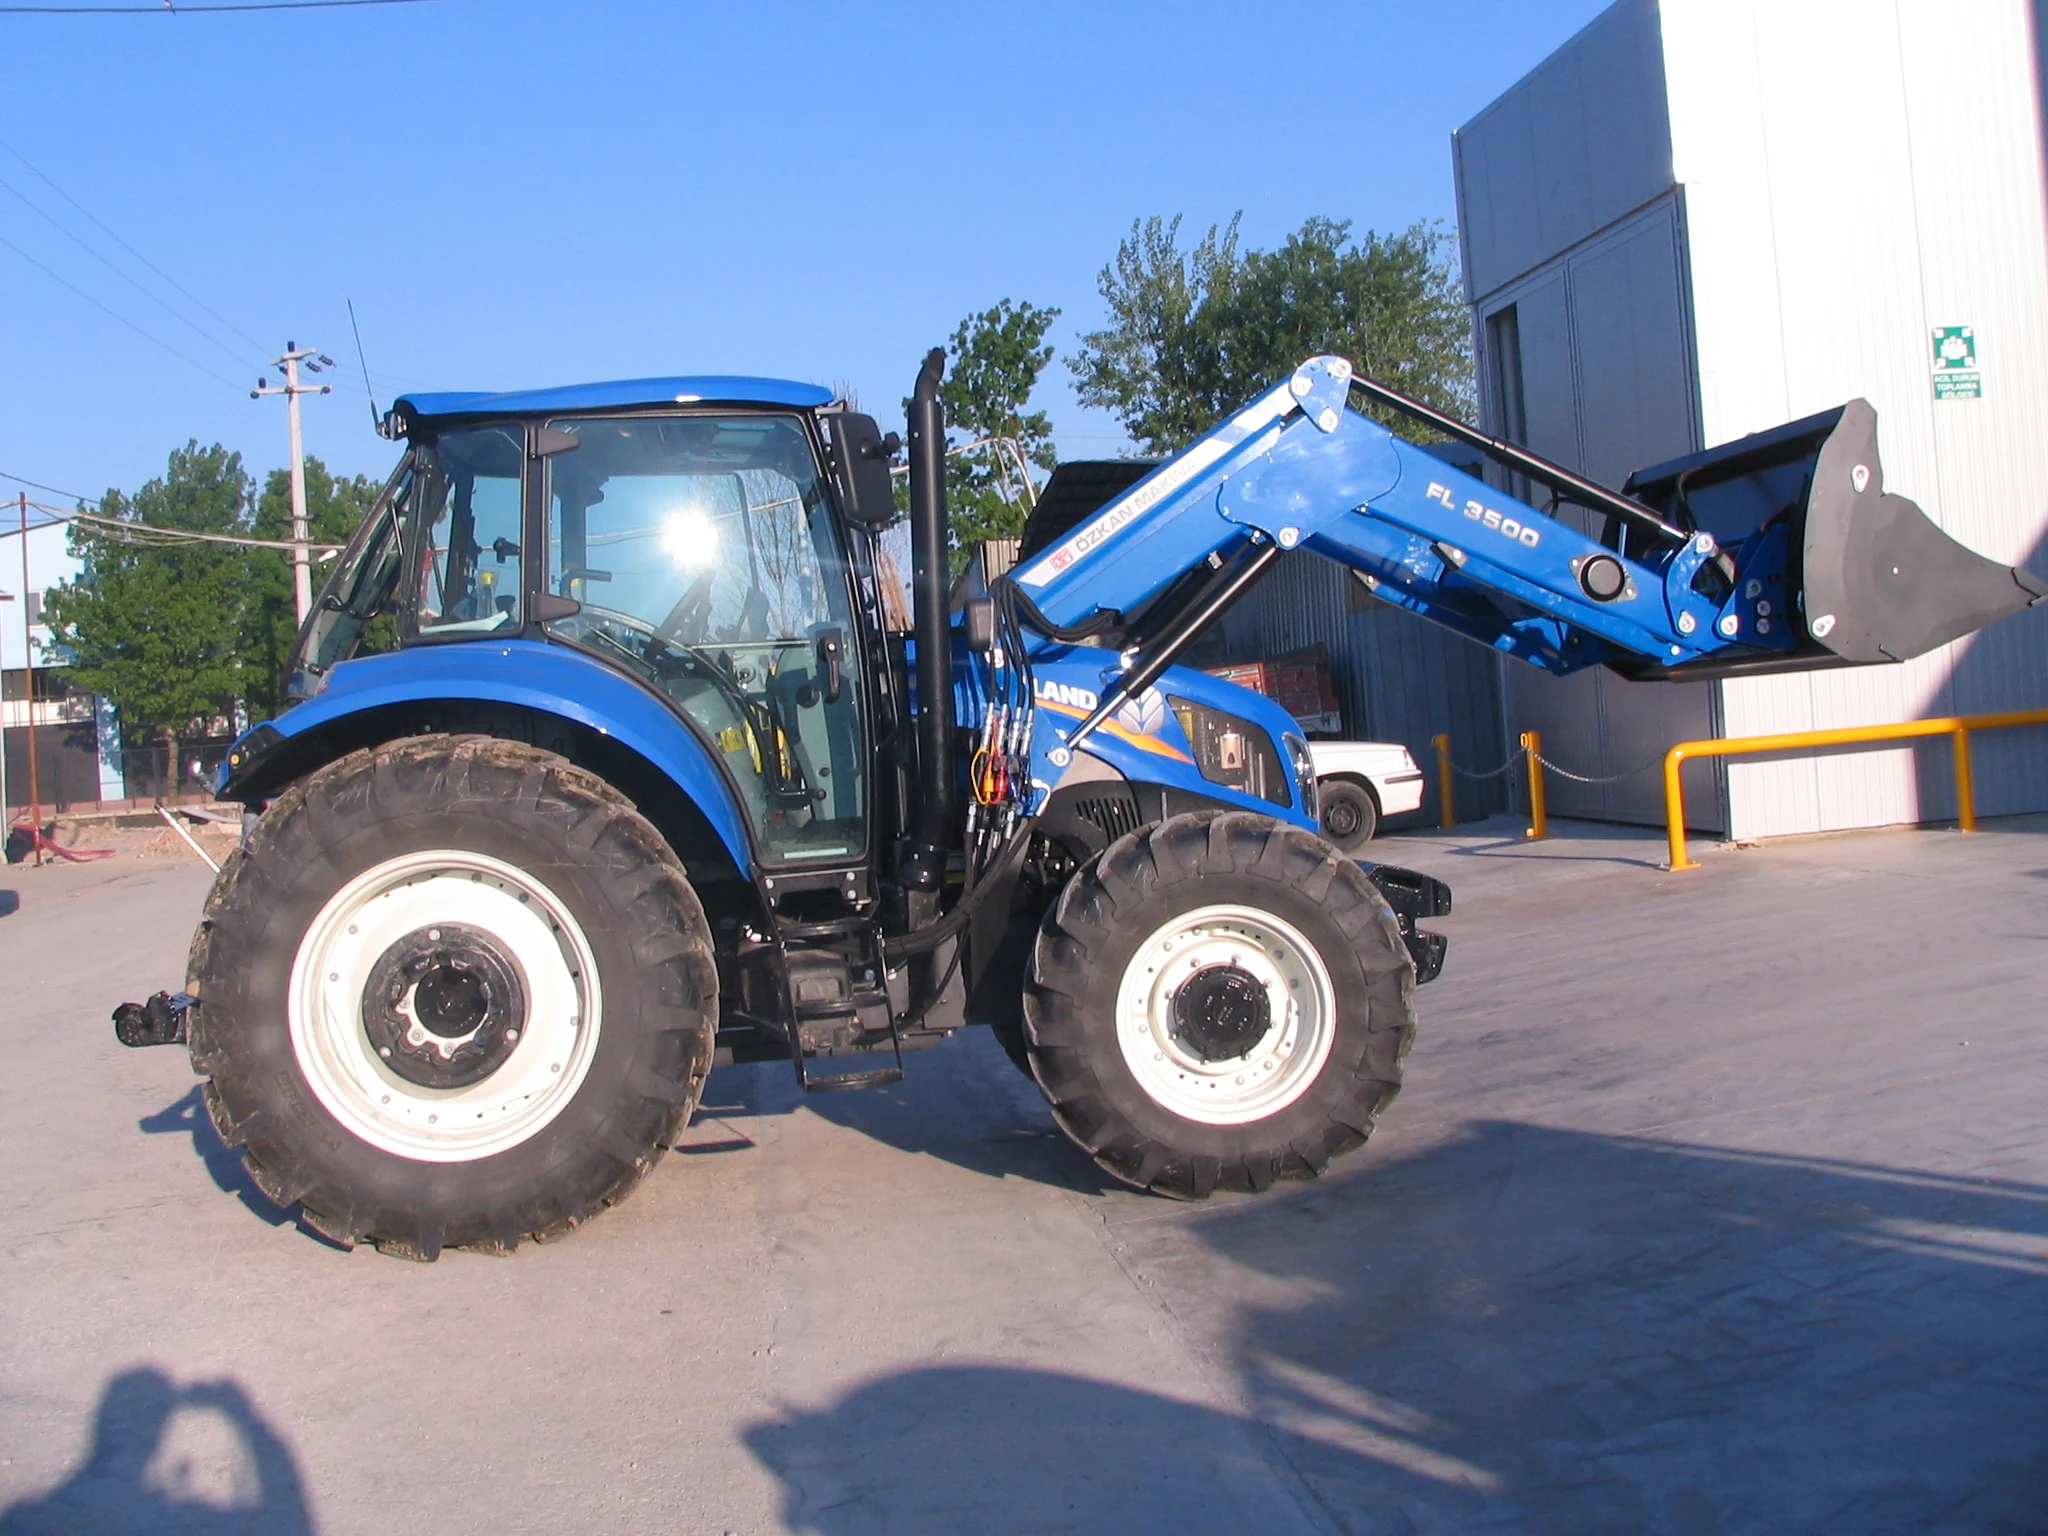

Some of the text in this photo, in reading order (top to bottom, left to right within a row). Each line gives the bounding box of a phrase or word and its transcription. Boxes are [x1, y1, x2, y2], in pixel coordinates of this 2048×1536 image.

[1075, 504, 1133, 552] ÖZKAN
[1425, 481, 1540, 548] FL 3500
